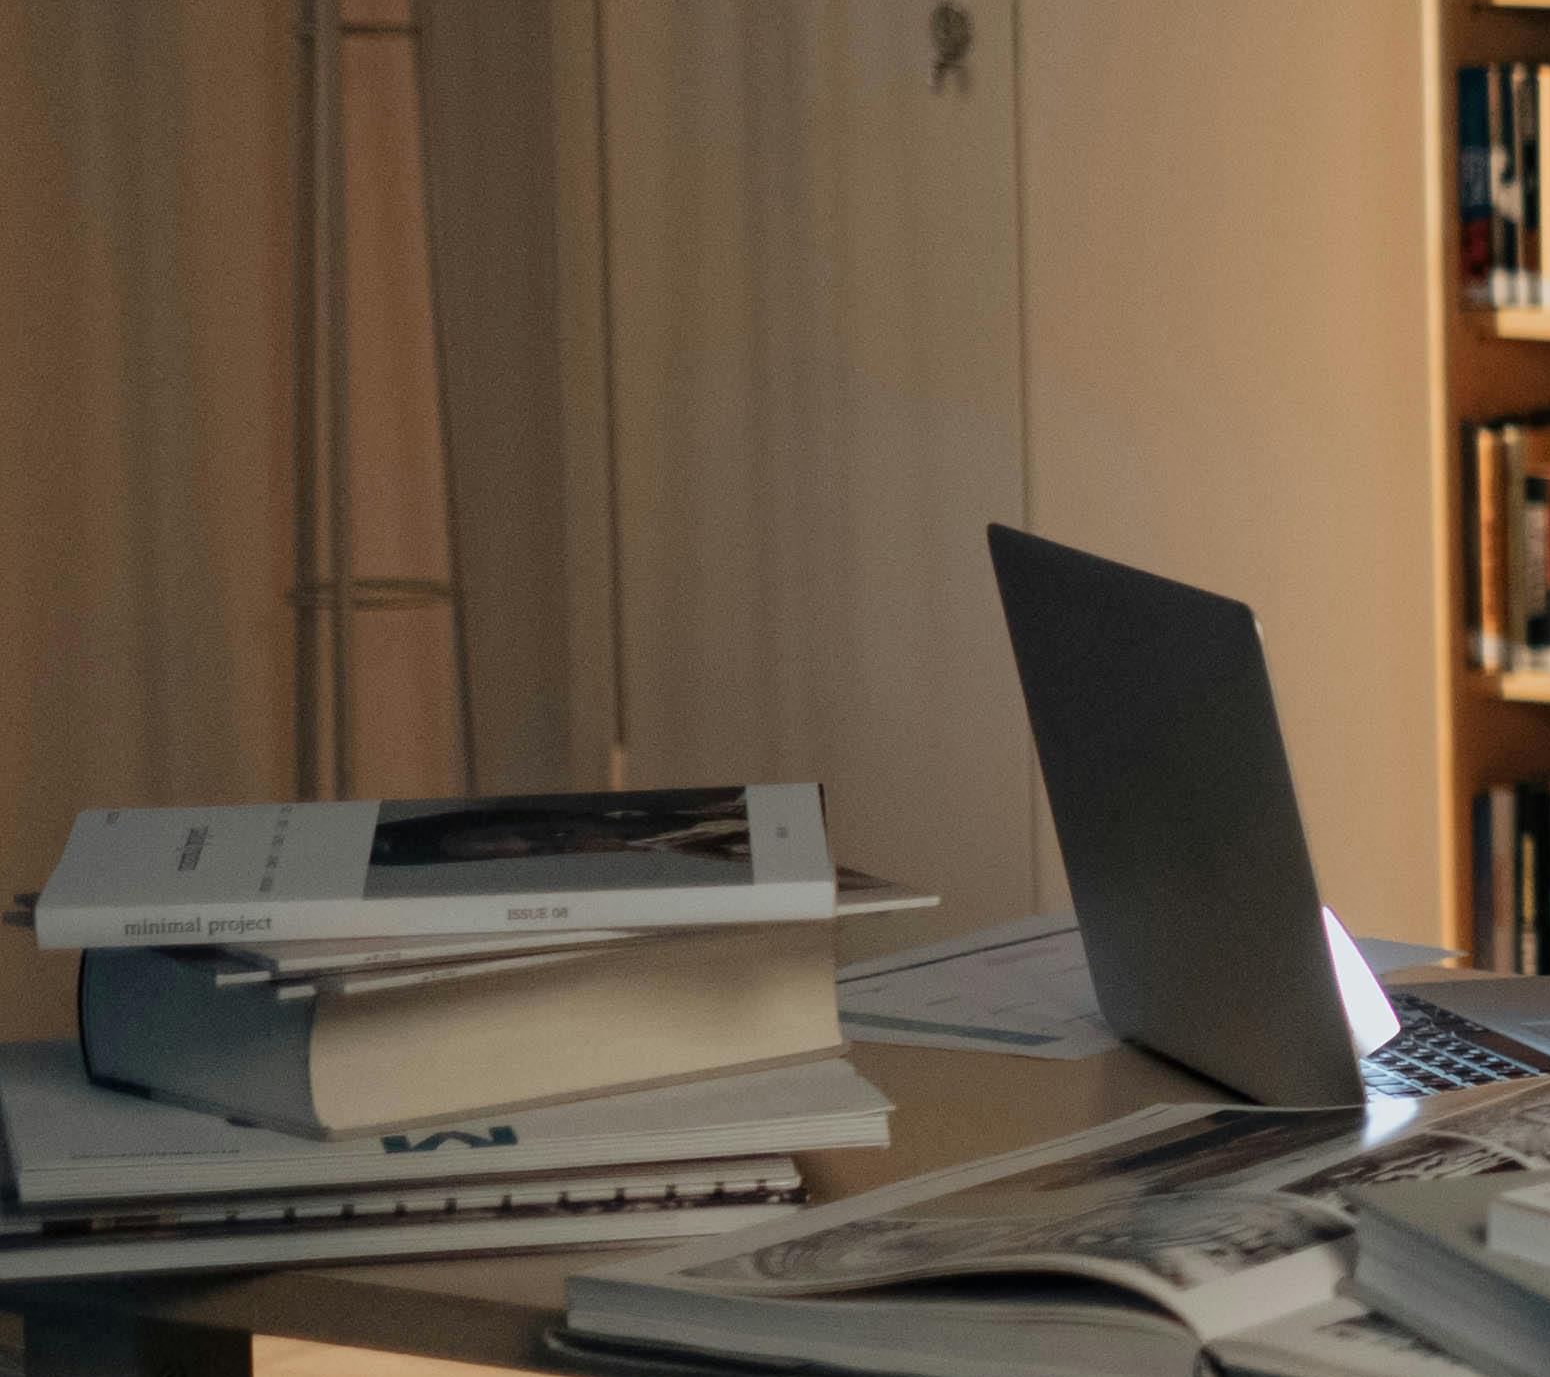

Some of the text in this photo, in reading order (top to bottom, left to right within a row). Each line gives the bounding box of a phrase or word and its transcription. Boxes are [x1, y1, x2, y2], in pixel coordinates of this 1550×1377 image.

[506, 907, 548, 920] ISSUE
[124, 914, 274, 936] minimal project
